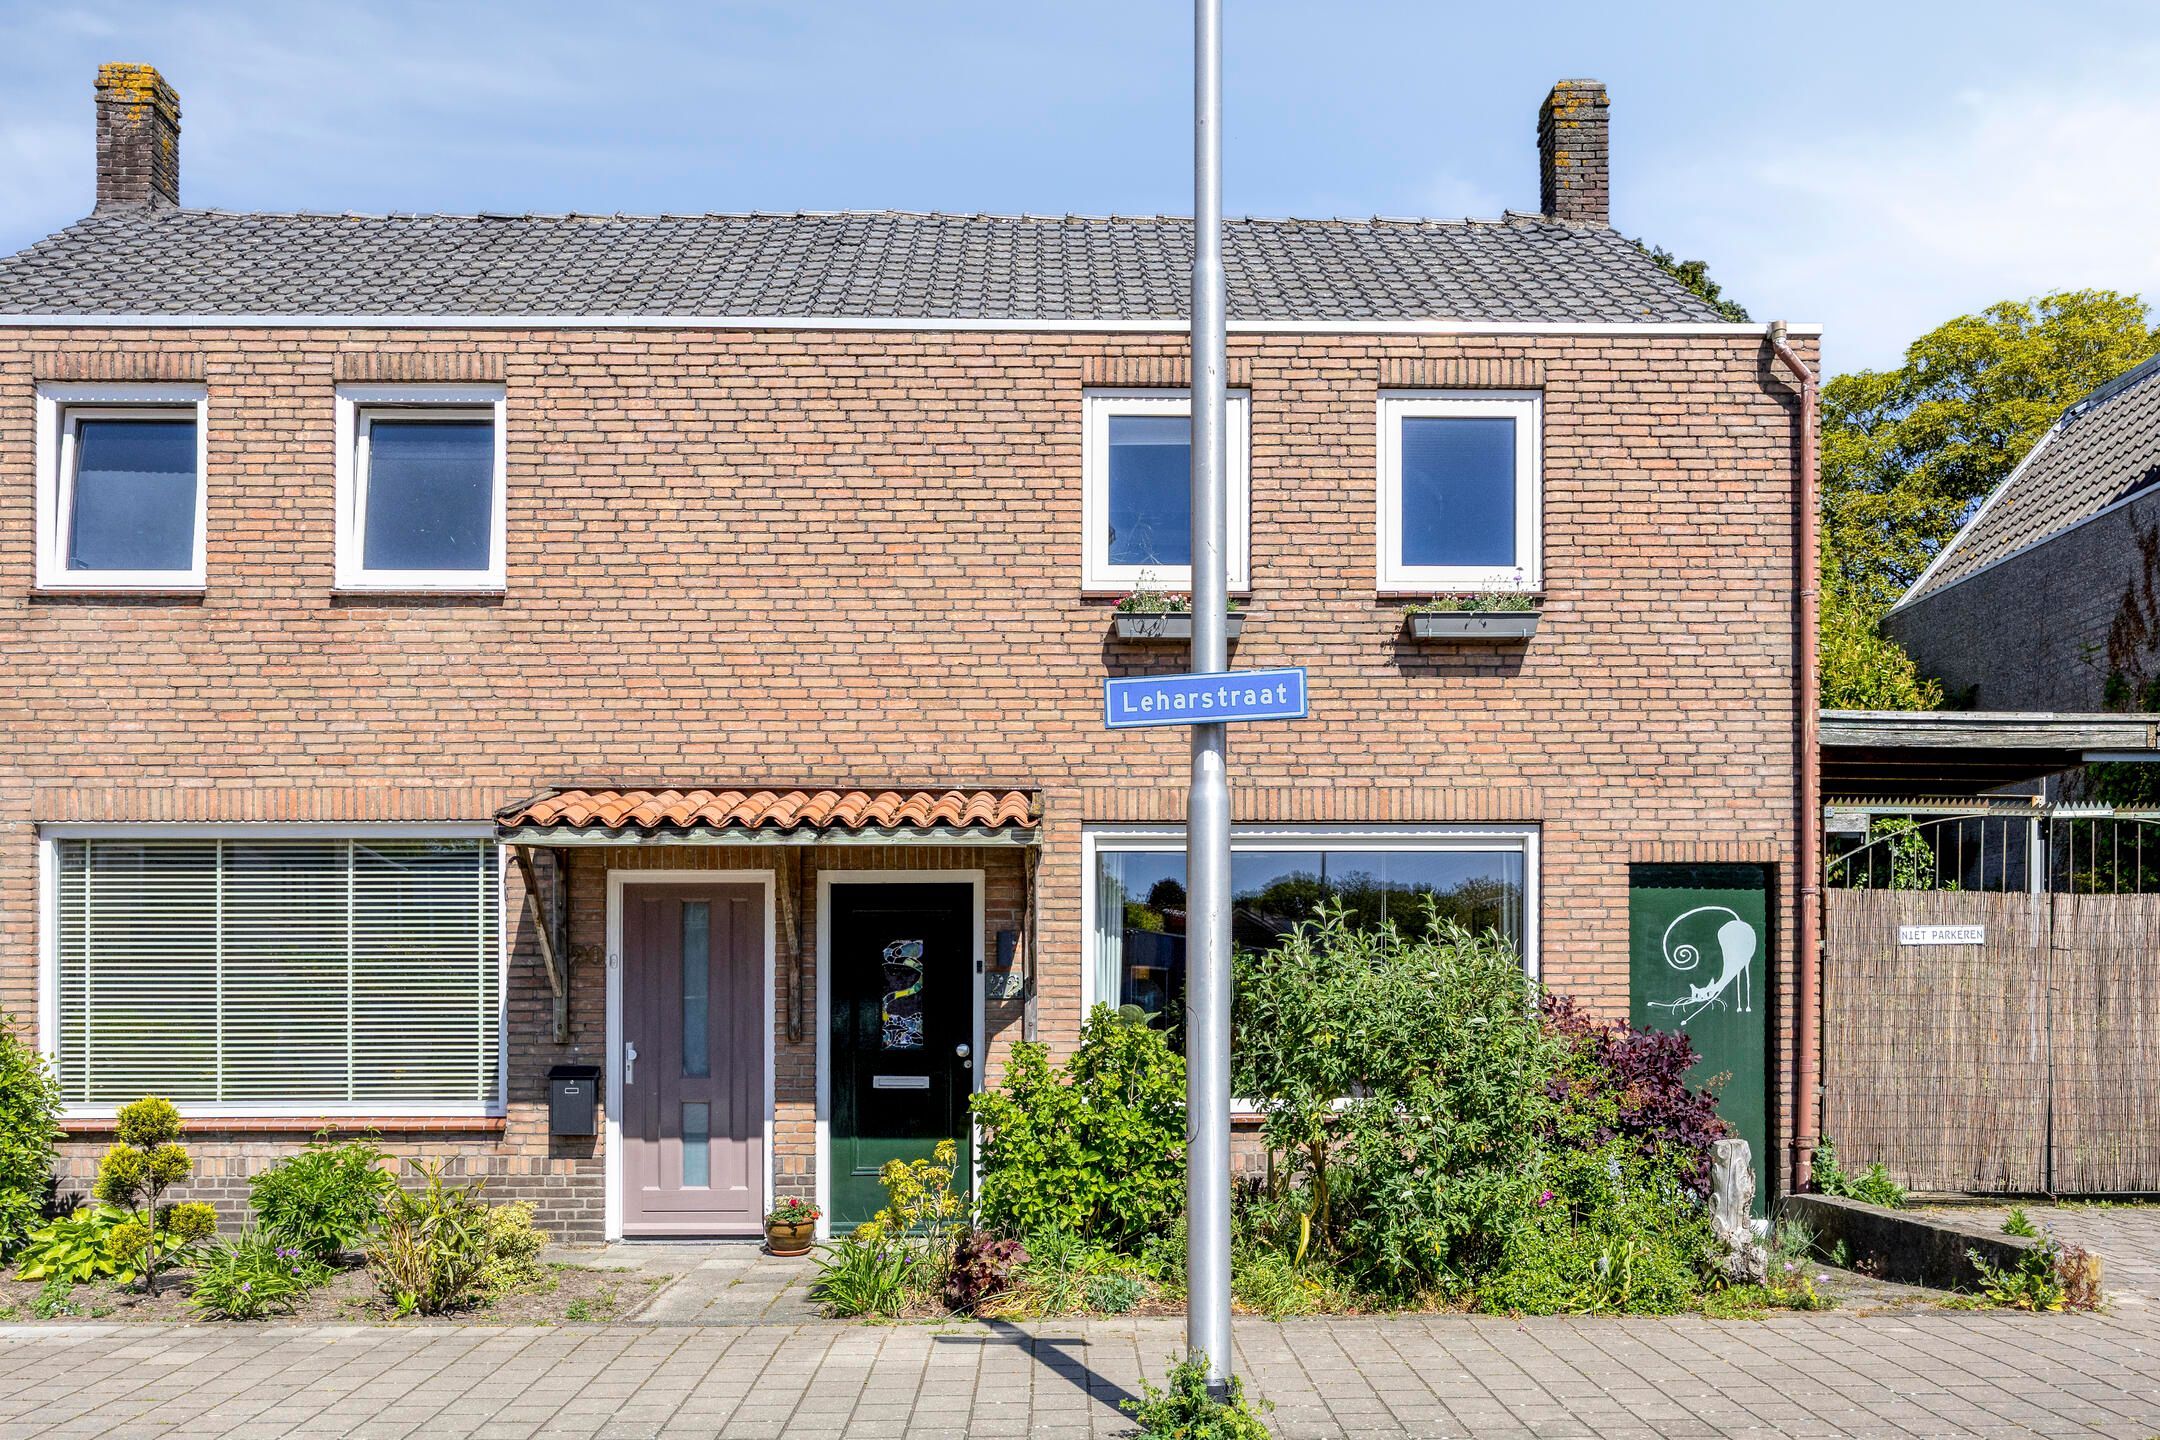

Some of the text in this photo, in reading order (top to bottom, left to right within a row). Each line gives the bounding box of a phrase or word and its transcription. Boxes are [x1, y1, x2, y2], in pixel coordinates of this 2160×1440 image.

[1122, 682, 1287, 713] Leharstraat
[1901, 929, 1983, 940] NIET PARKEREN
